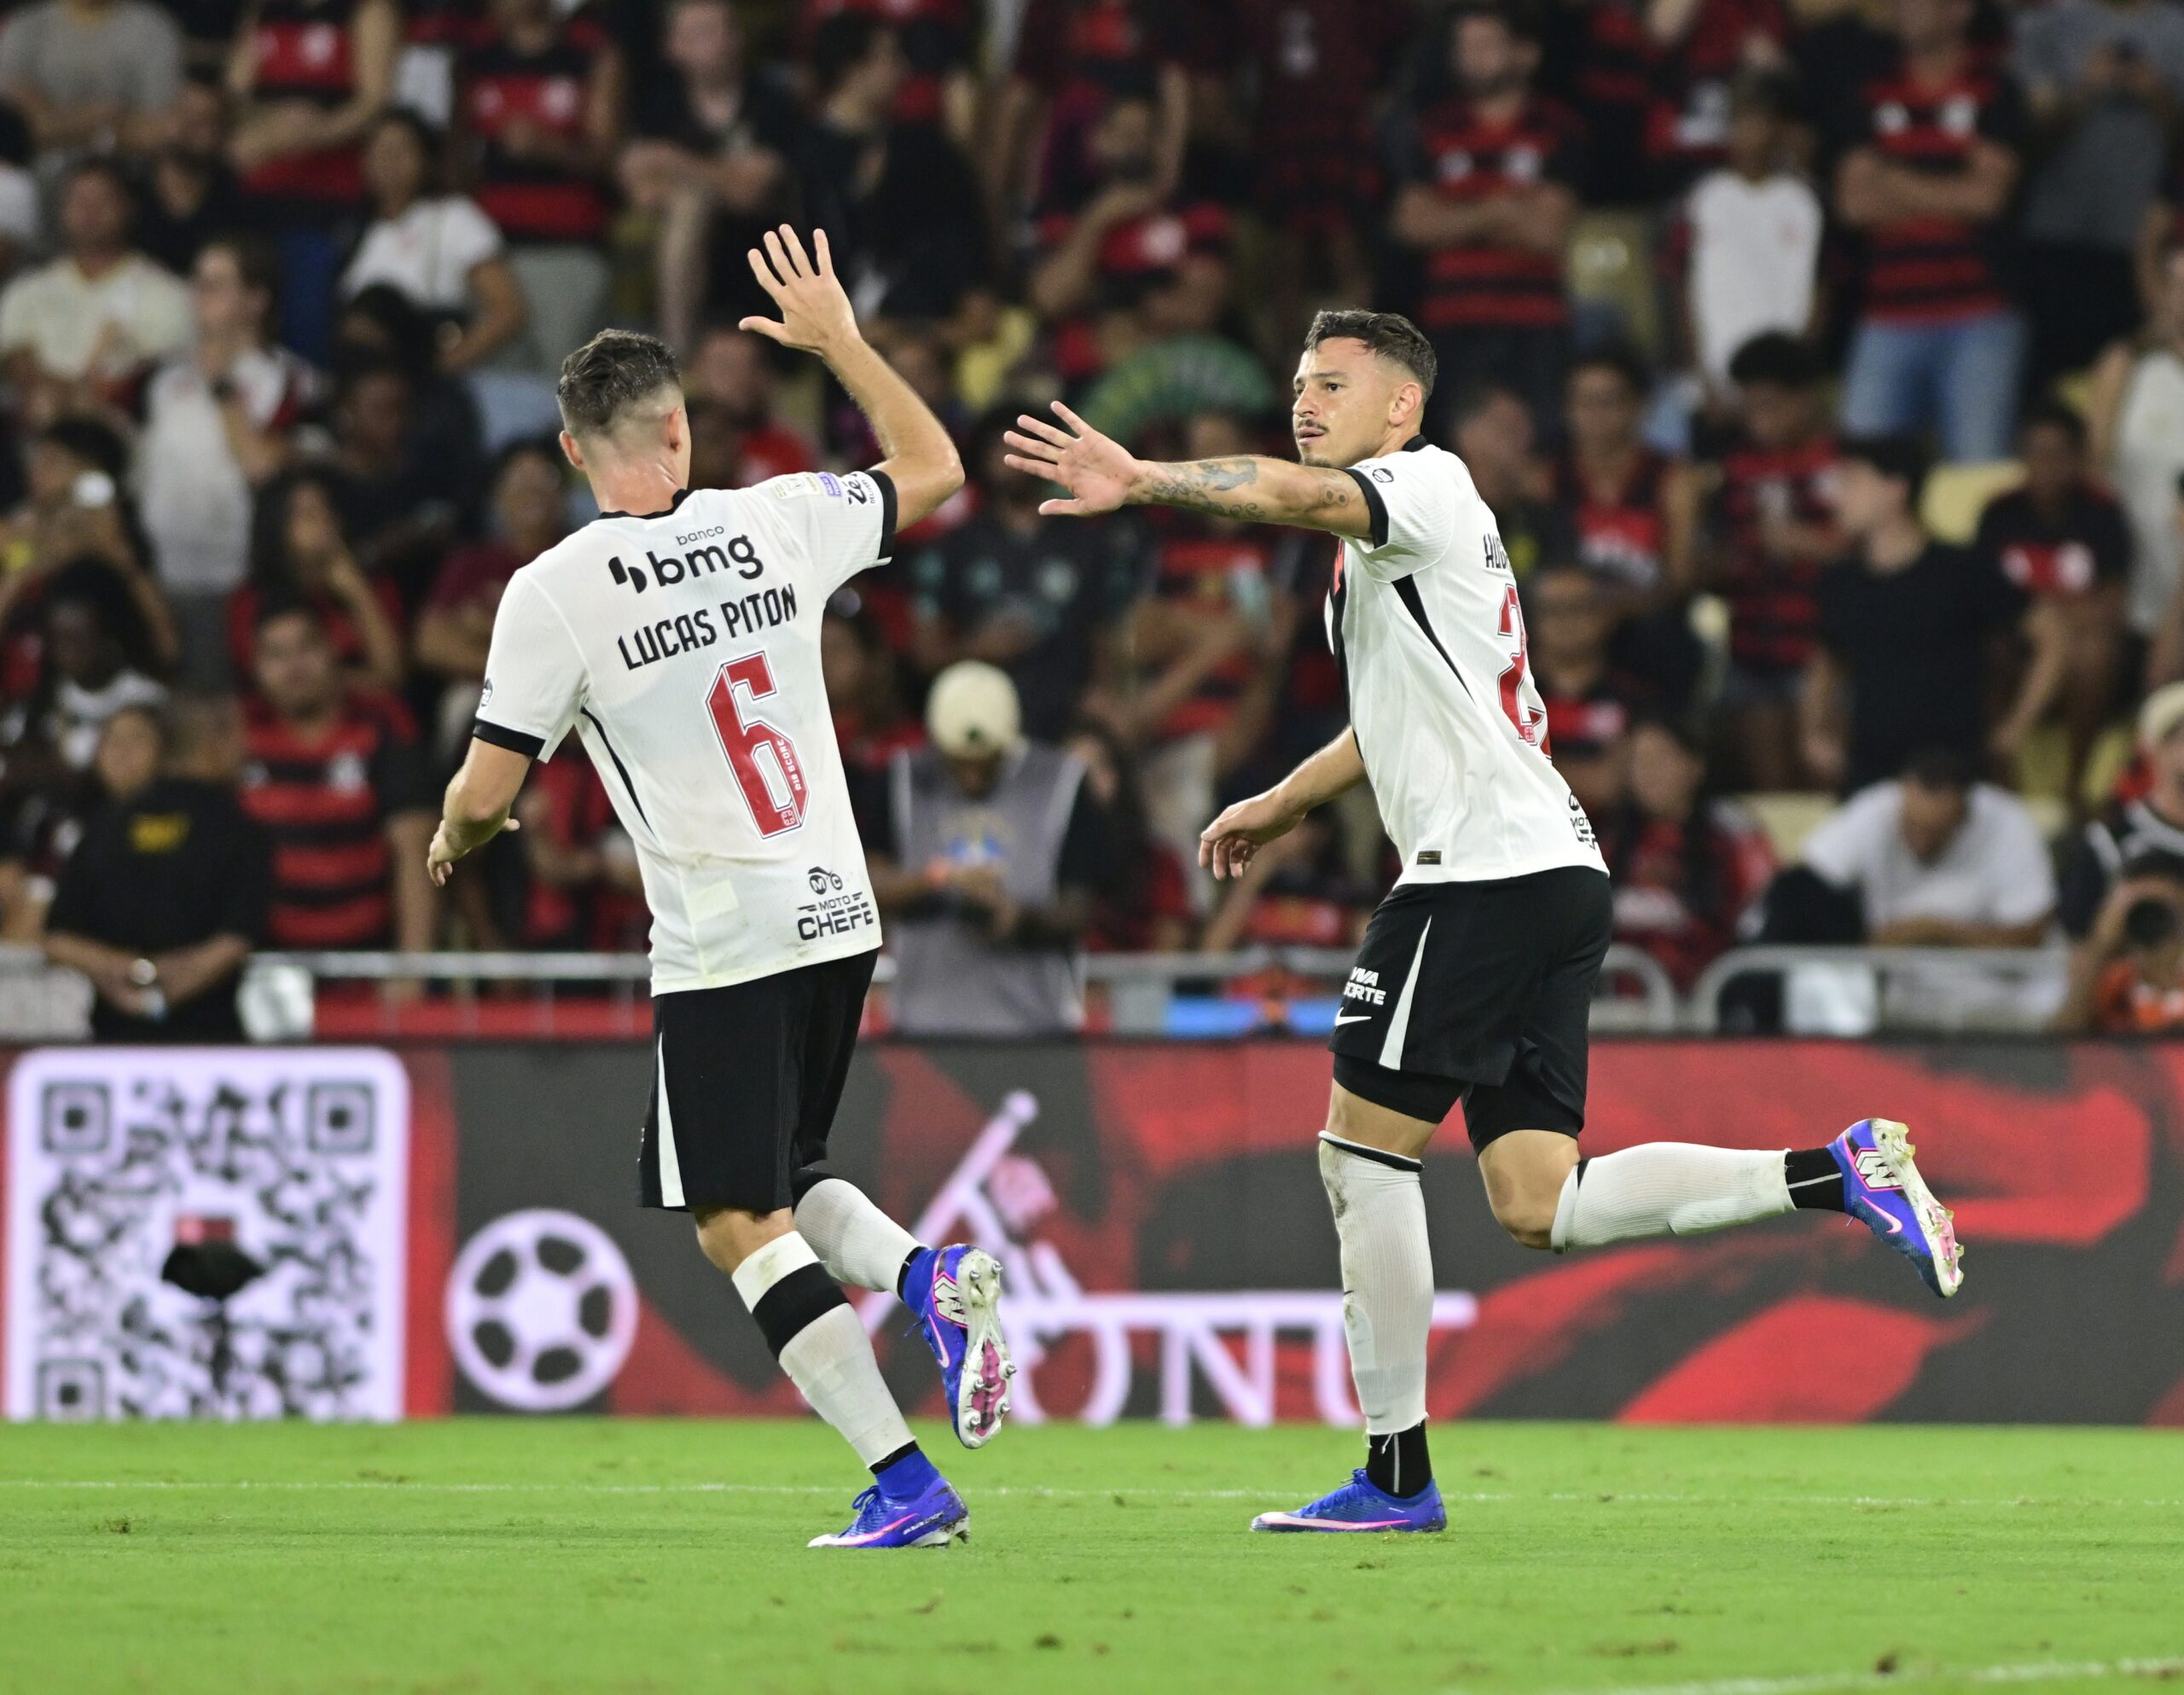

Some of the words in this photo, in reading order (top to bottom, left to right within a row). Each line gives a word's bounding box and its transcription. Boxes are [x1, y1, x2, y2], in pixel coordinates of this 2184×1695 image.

[676, 525, 724, 546] banco
[646, 534, 764, 587] bmg
[618, 609, 717, 670] LUCAS
[721, 583, 797, 638] PITON
[706, 651, 810, 840] 6
[777, 739, 796, 772] SCORE
[798, 902, 874, 940] CHEFE
[819, 895, 851, 911] MOTO
